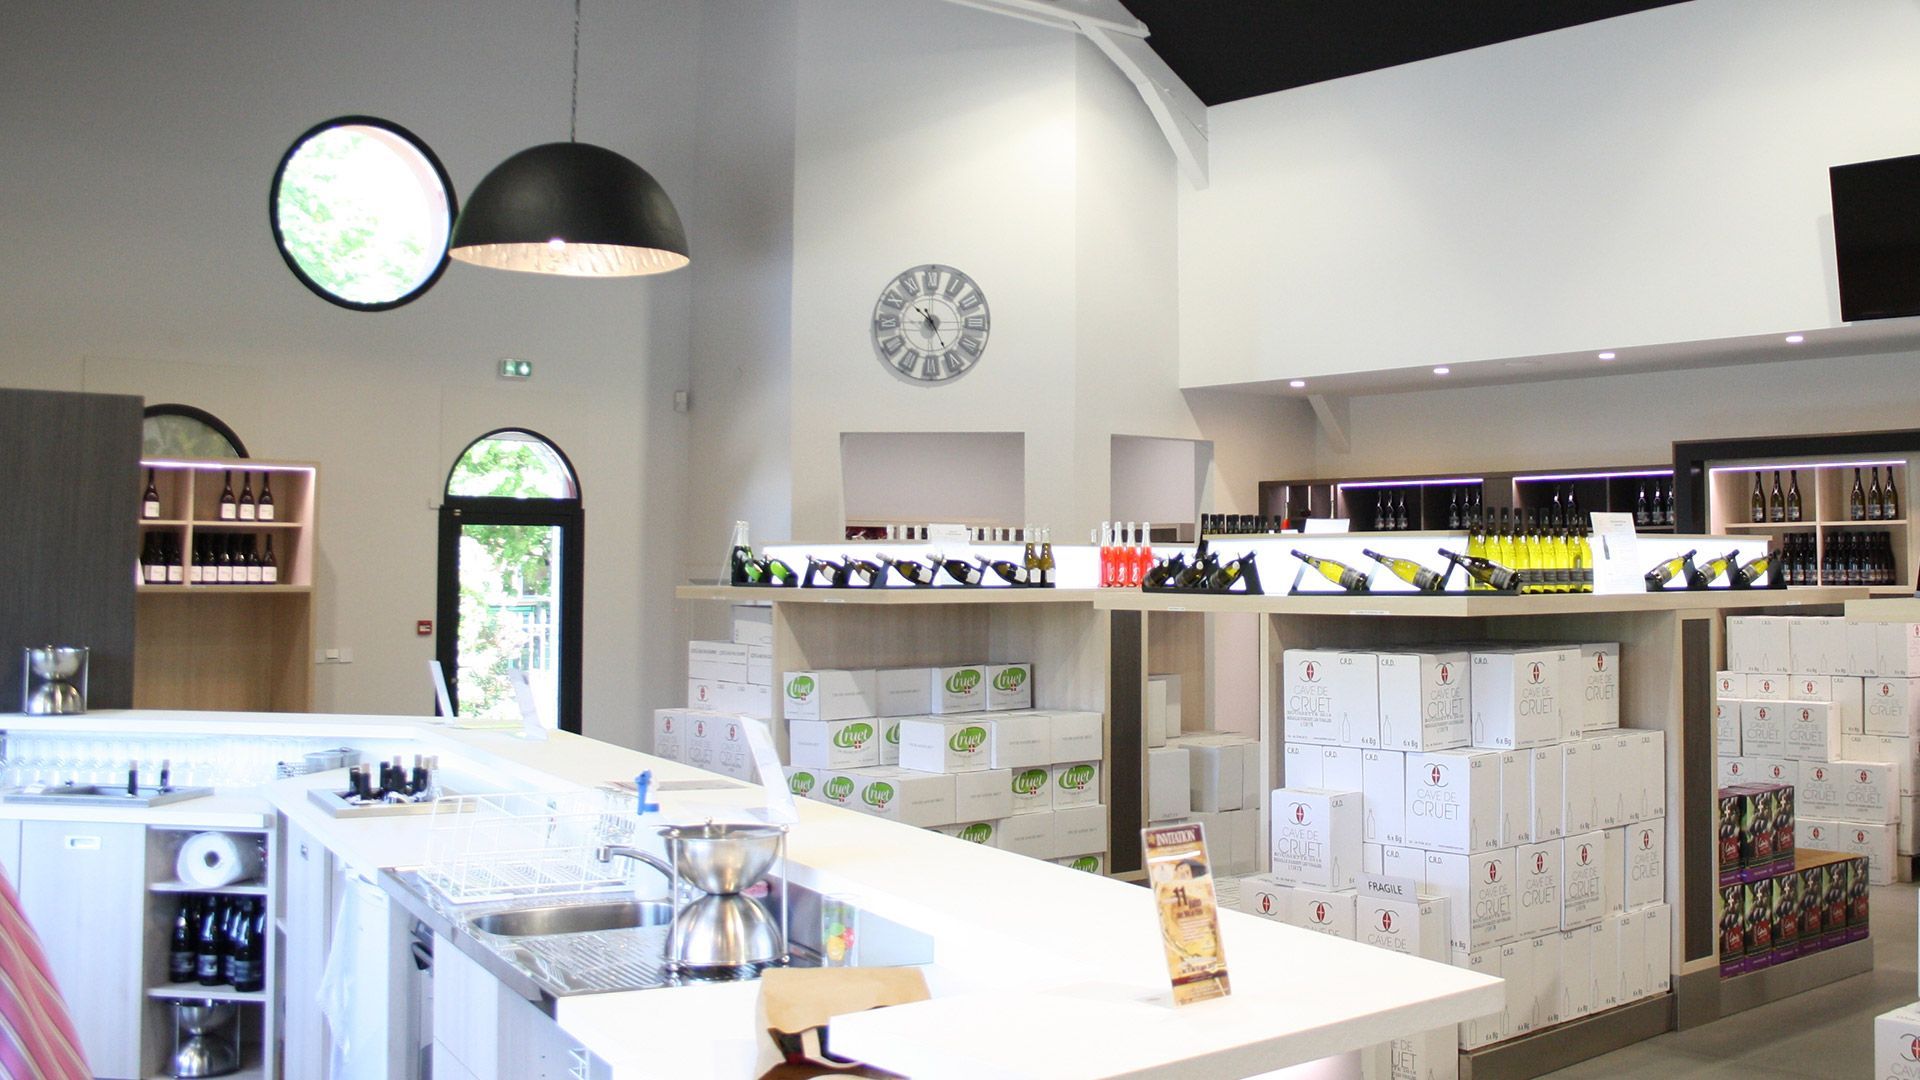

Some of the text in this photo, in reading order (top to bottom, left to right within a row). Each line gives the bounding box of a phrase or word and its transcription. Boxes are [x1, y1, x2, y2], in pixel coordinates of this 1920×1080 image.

[951, 670, 977, 692] Cruet
[998, 669, 1022, 690] Cruet
[1294, 685, 1328, 696] CAVE DE
[1431, 687, 1460, 700] CAVE DE
[1522, 686, 1550, 698] CAVE DE
[1585, 684, 1615, 701] CRUET
[1290, 695, 1332, 713] CRUET
[1427, 698, 1464, 719] CRUET
[1520, 697, 1553, 716] CRUET
[839, 725, 868, 746] Cruet
[953, 728, 981, 751] Cruet
[1015, 770, 1043, 793] Cruet
[1063, 765, 1090, 789] Cruet
[827, 777, 850, 798] Cruet
[866, 782, 890, 804] Cruet
[1417, 788, 1456, 802] CAVE DE
[1412, 800, 1460, 820] CRUET
[1282, 826, 1319, 840] CAVE DE
[1279, 837, 1322, 858] CRUET
[1368, 881, 1402, 895] FRAGILE
[1522, 886, 1556, 907] CRUET
[1476, 895, 1510, 918] CRUET
[1368, 934, 1407, 949] CAVE DE
[1391, 1051, 1417, 1070] UET
